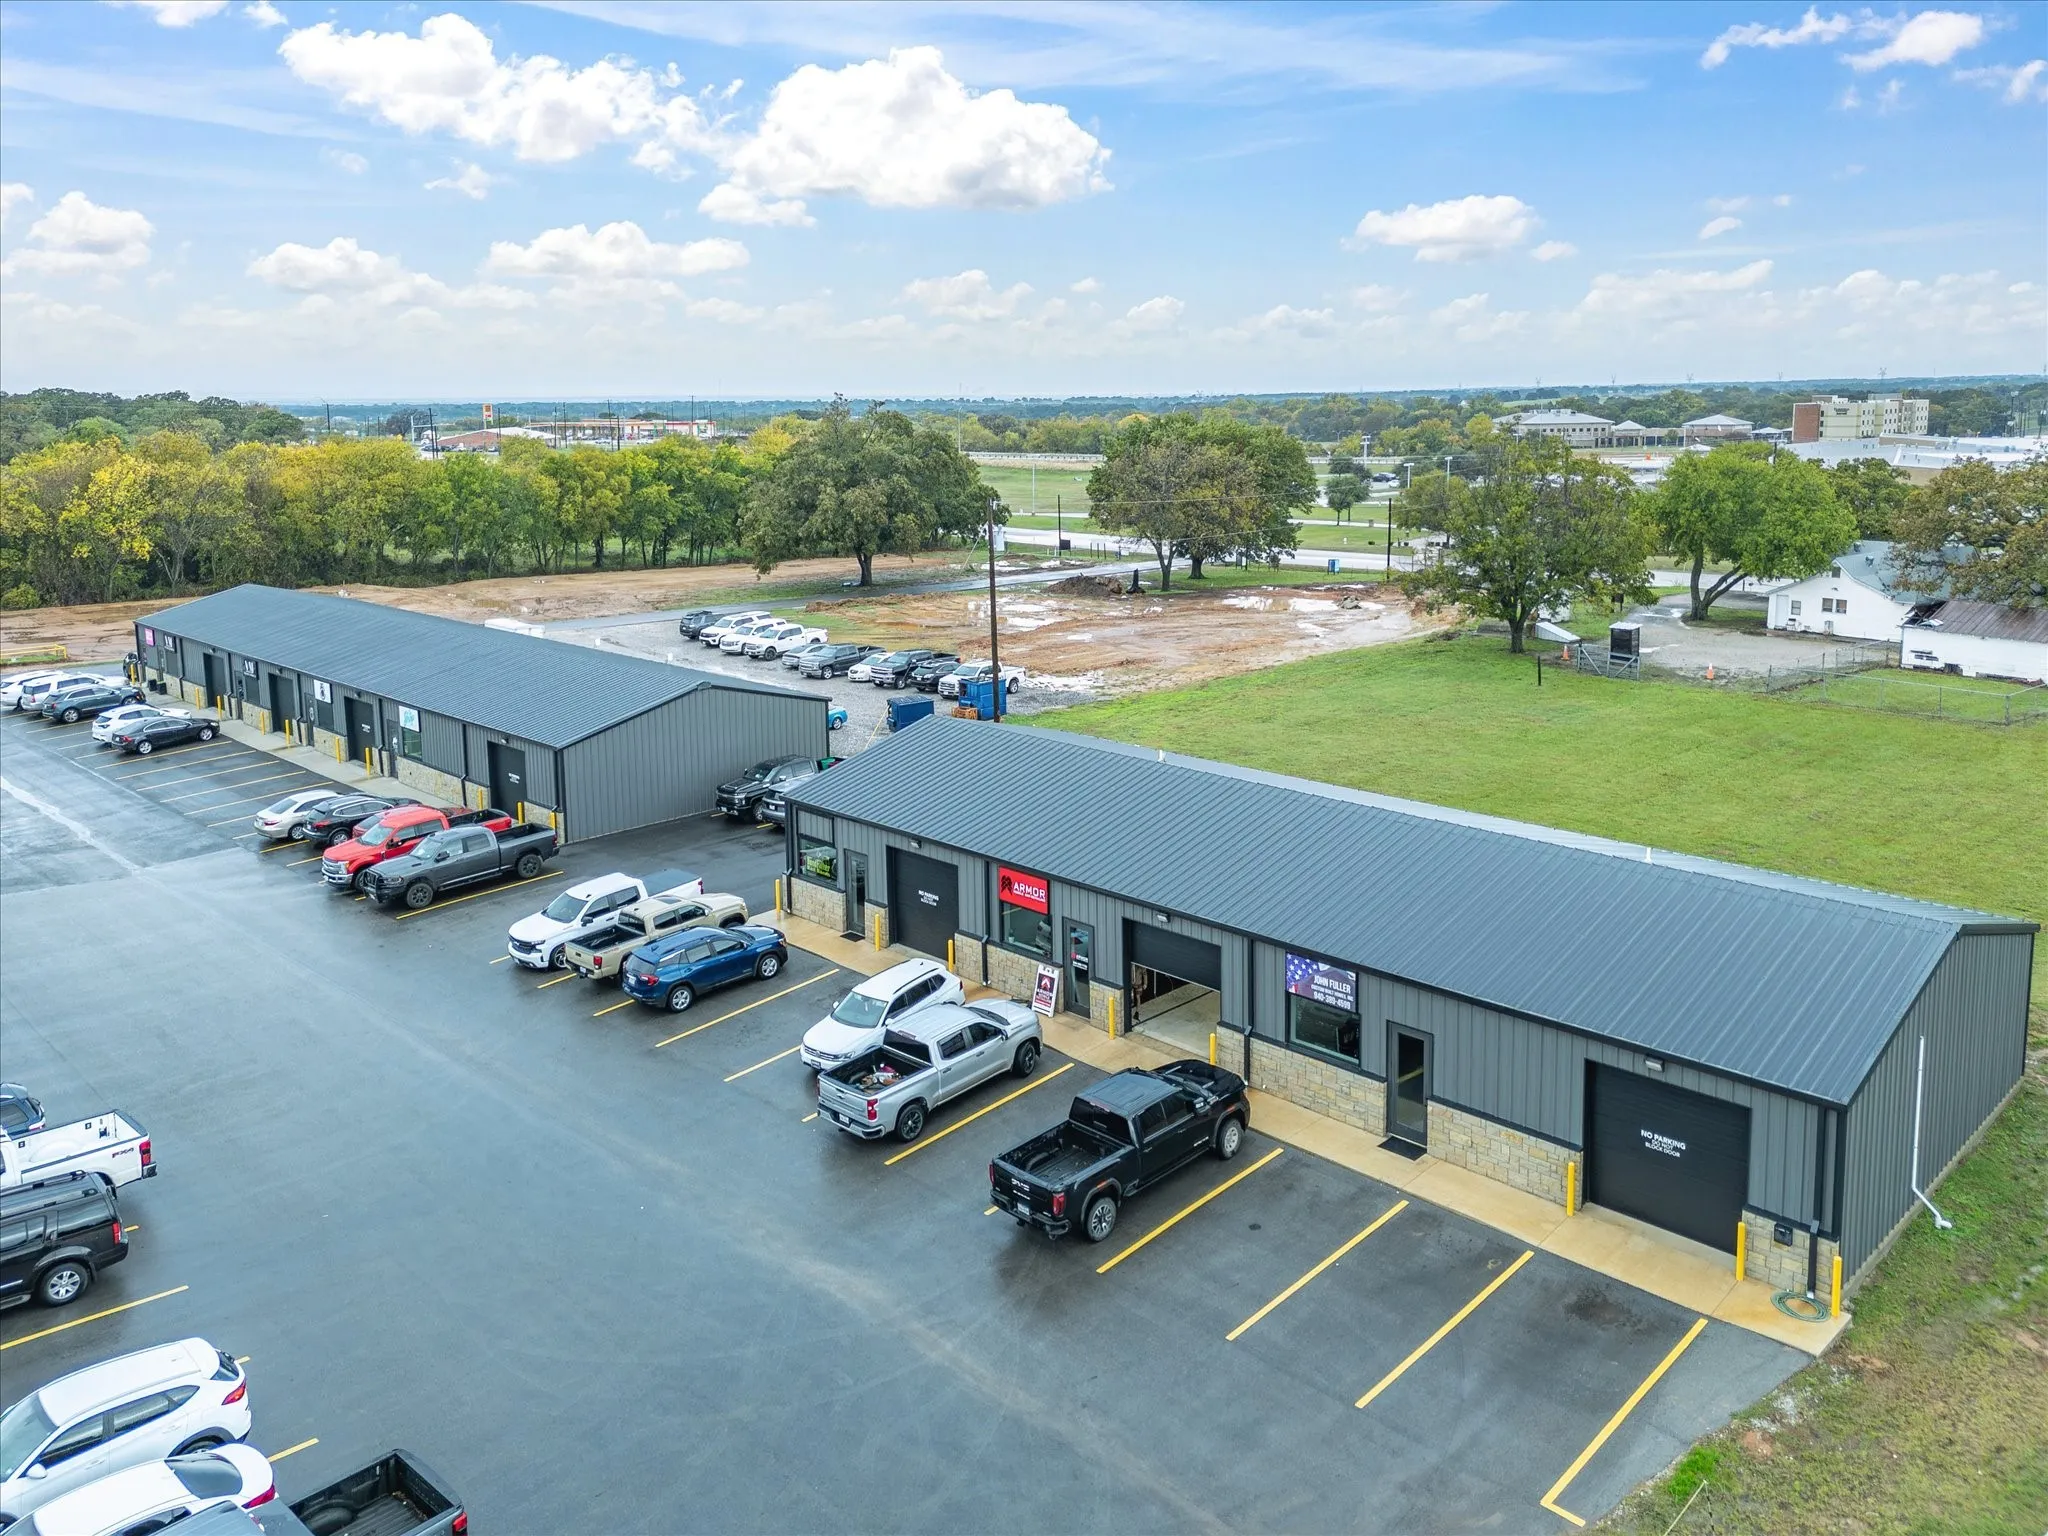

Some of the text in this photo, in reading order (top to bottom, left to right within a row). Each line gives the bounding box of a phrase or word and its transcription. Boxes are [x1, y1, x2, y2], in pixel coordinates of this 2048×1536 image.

[1013, 881, 1046, 899] ARMOR
[1314, 975, 1350, 994] JOHN FULLER
[1641, 1129, 1686, 1150] NO PARKING
[1661, 1142, 1673, 1150] NOT
[1645, 1142, 1680, 1157] BLOCK DOOR
